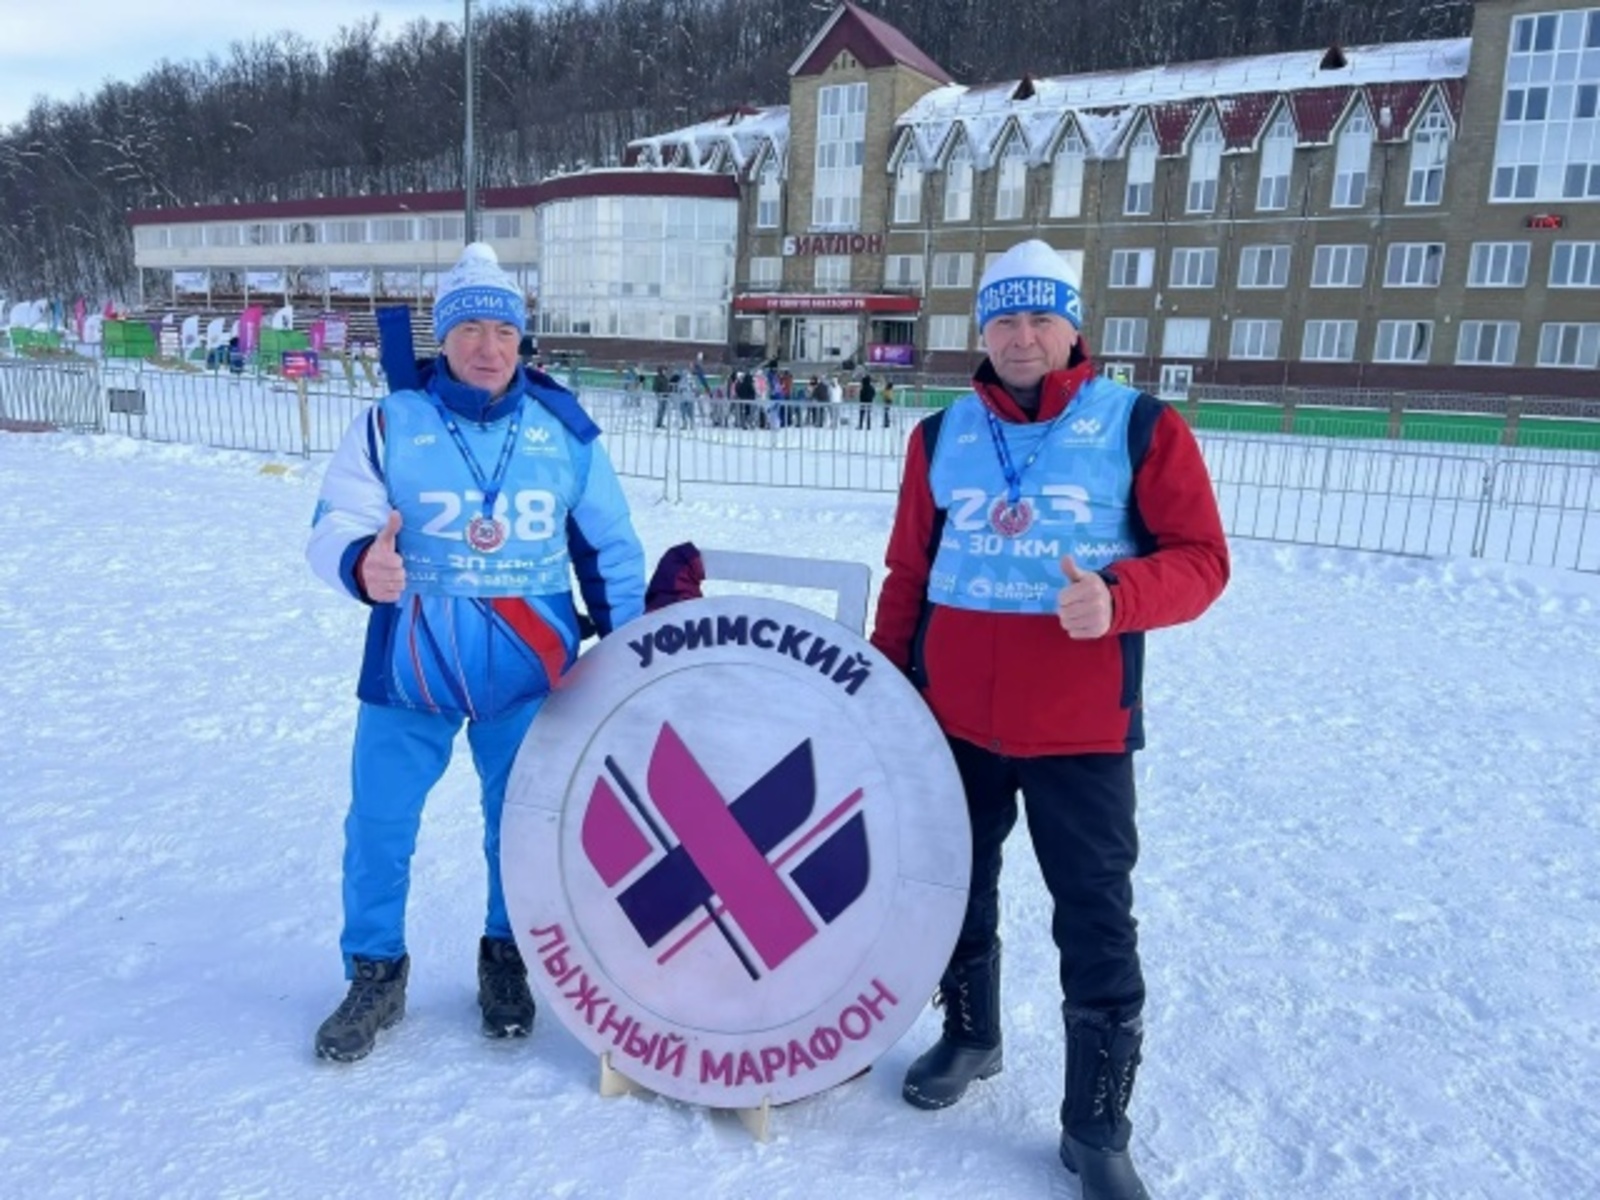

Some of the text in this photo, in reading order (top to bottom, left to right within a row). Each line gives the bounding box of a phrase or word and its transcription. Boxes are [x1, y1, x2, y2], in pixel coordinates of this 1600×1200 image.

[782, 234, 883, 256] БИАТЛОН
[951, 484, 1093, 531] 23
[969, 533, 1003, 556] 30
[1012, 539, 1060, 558] КМ
[628, 615, 873, 697] УФИМСКИЙ
[529, 922, 900, 1087] ЛЫЖНЫЙ МАРАФОН
